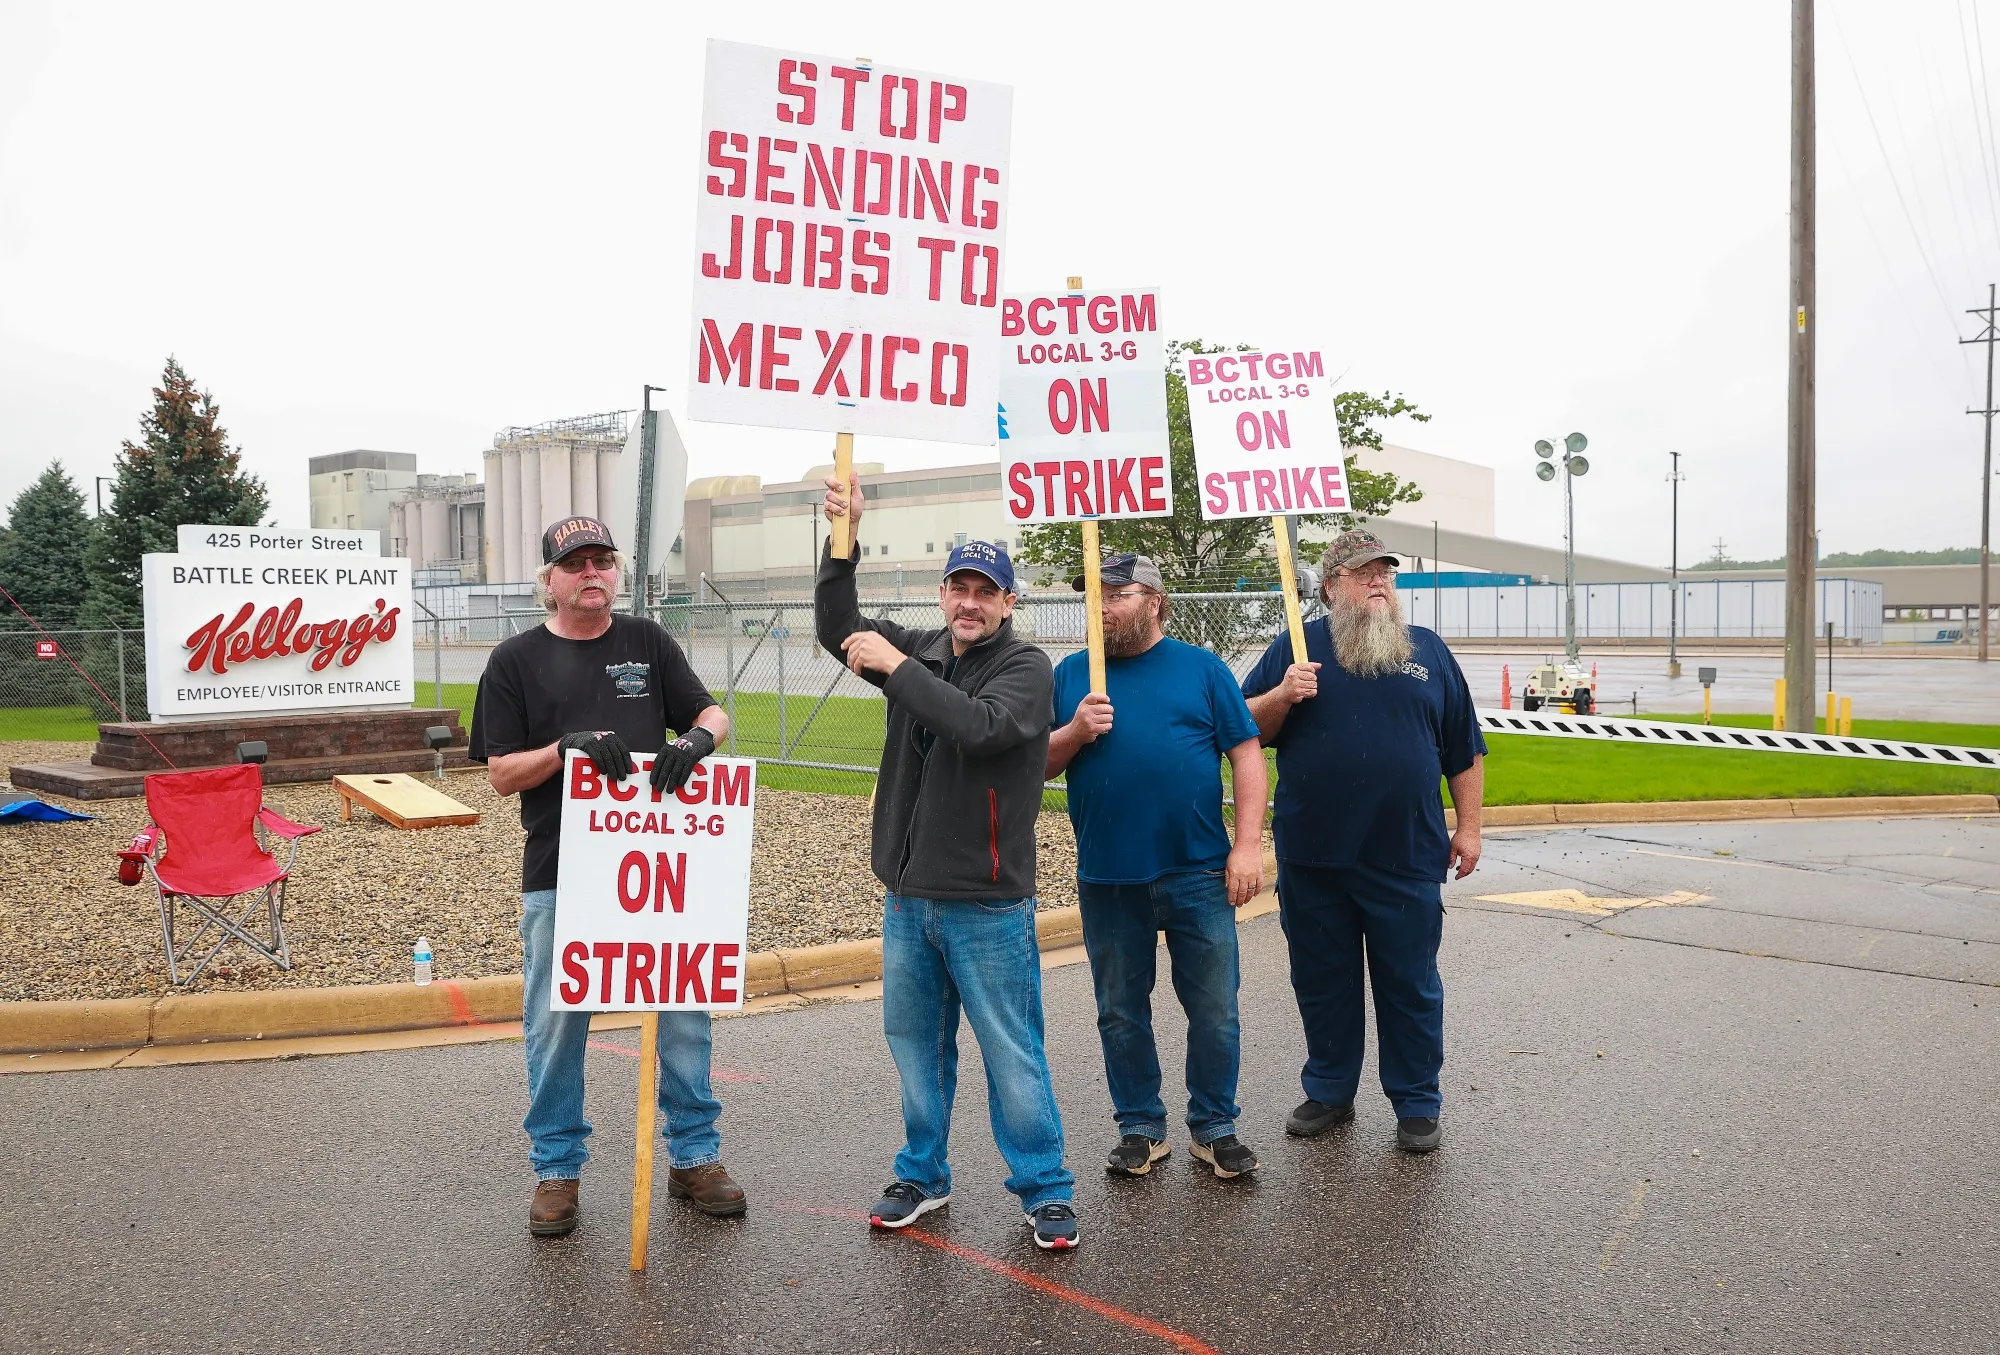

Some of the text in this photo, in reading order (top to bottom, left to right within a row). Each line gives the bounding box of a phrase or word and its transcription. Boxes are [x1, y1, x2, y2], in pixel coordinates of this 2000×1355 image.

[775, 58, 967, 143] STOP
[706, 130, 1000, 230] SENDING
[702, 215, 999, 308] JOBS TO
[1001, 294, 1157, 336] BCTGM
[698, 318, 969, 408] MEXICO
[1017, 340, 1137, 364] LOCAL 3-G
[1188, 351, 1325, 386] BCTGM
[1048, 377, 1110, 435] ON
[1207, 383, 1310, 404] LOCAL 3-G
[1236, 409, 1291, 452] ON
[1008, 456, 1166, 519] STRIKE
[1205, 466, 1346, 515] STRIKE
[206, 533, 363, 551] 425 Porter Street
[554, 519, 604, 548] HARLEY
[962, 543, 997, 559] BCTGM
[173, 566, 398, 586] BATTLE CREEK PLANT
[960, 551, 982, 559] LOCAL
[40, 643, 53, 652] NO
[185, 597, 401, 674] Kellogg's
[177, 680, 401, 701] EMPLOYEE/VISITOR ENTRANCE
[589, 810, 725, 836] LOCAL 3-G
[617, 850, 687, 914] ON
[559, 940, 740, 1005] STRIKE
